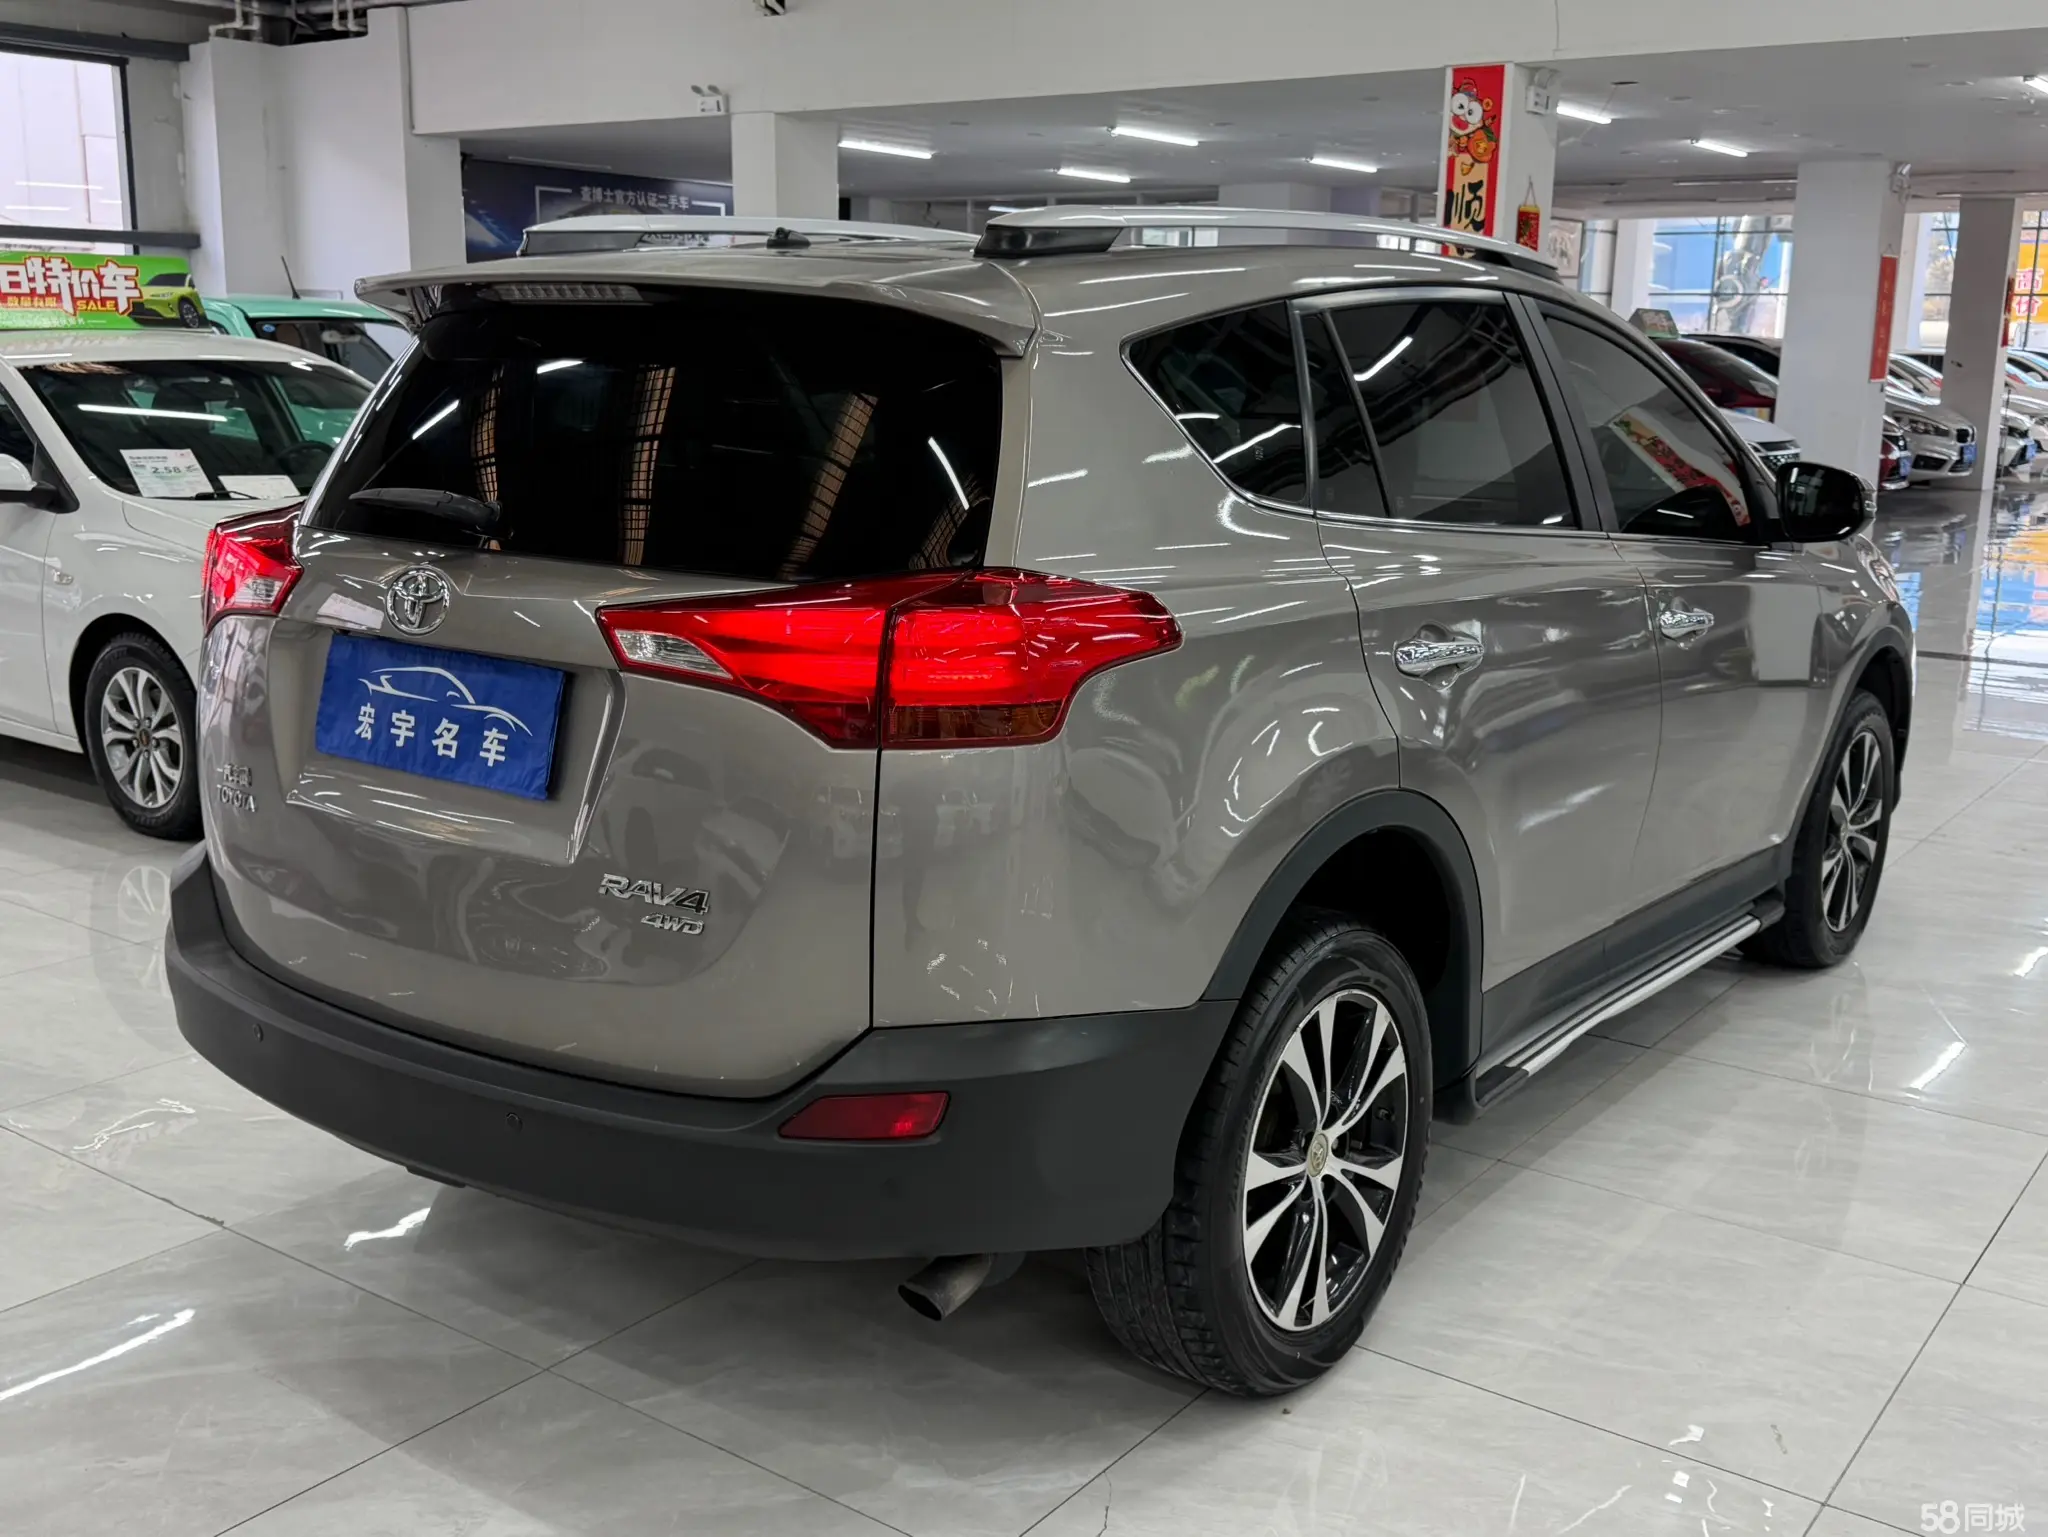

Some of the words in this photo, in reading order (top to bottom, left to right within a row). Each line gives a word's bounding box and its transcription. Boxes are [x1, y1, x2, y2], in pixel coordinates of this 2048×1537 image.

[77, 300, 116, 311] SALE
[354, 702, 509, 767] 宏宇名车
[216, 784, 256, 813] TOYOTA
[598, 873, 710, 915] RAV4
[640, 913, 704, 935] 4WD
